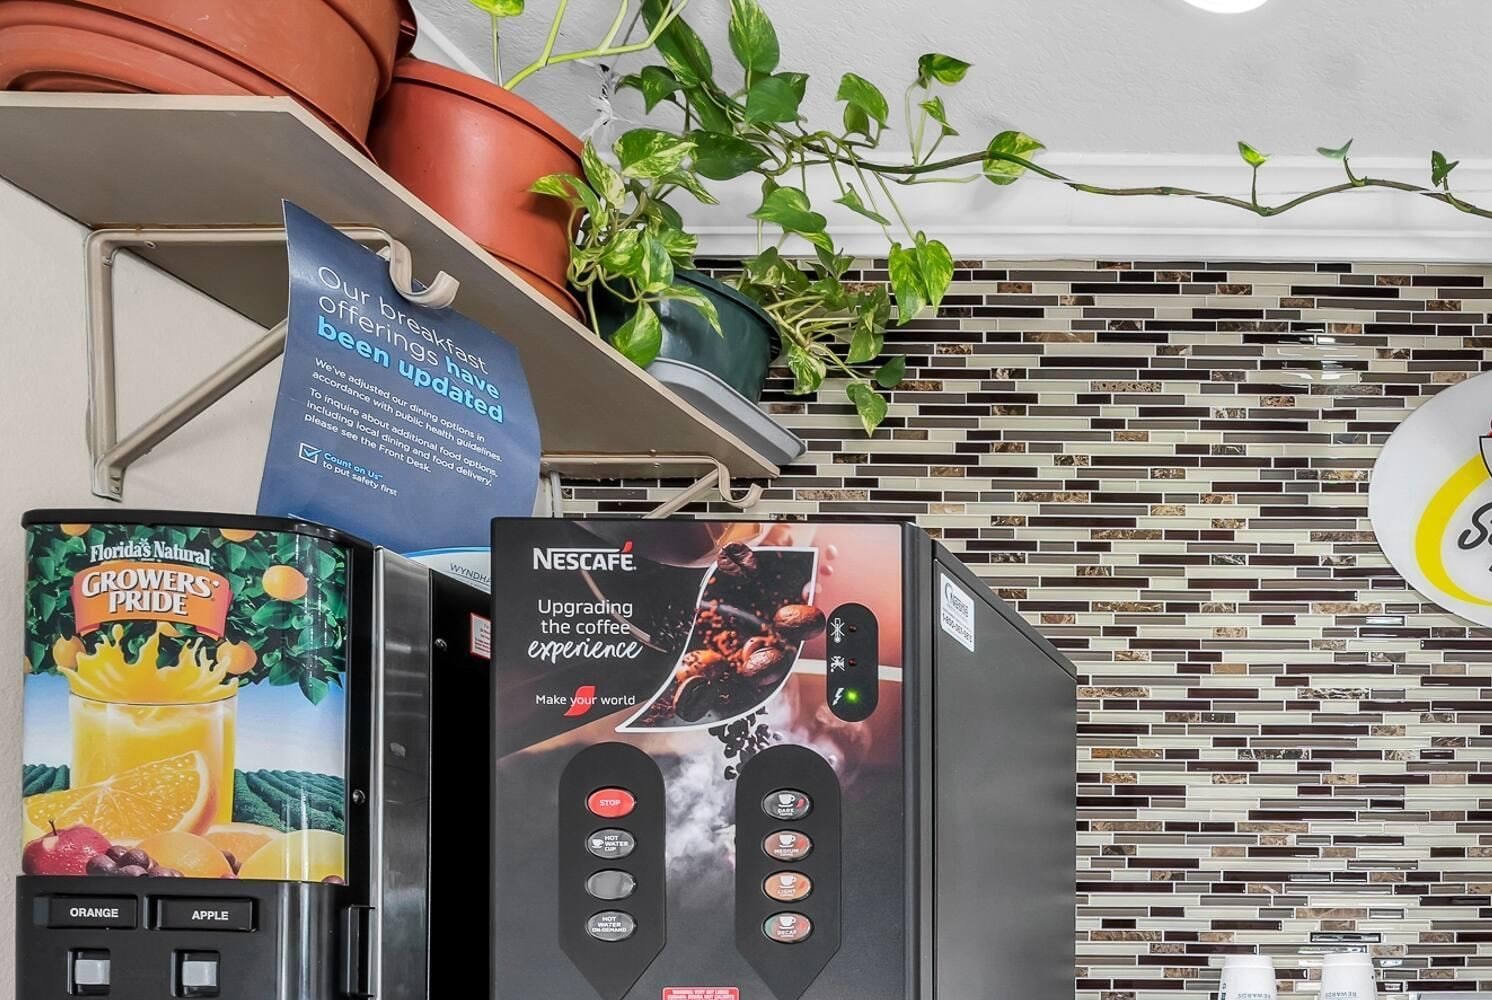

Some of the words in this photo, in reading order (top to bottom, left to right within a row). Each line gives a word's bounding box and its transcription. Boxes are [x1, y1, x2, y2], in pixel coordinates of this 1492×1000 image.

[318, 266, 370, 304] Our
[379, 296, 488, 375] breakfast
[319, 296, 439, 366] offerings
[445, 355, 500, 399] have
[317, 315, 390, 368] been
[399, 359, 503, 423] updated
[315, 357, 346, 379] We've
[348, 375, 390, 399] adjusted
[392, 396, 408, 408] our
[409, 404, 439, 423] dining
[440, 419, 475, 438] options
[476, 432, 485, 442] in
[310, 387, 322, 400] To
[324, 394, 360, 416] inquire
[361, 412, 390, 430] about
[392, 426, 438, 451] additional
[439, 446, 462, 461] food
[312, 371, 371, 402] accordance
[373, 399, 394, 414] with
[395, 409, 424, 428] public
[426, 422, 454, 441] health
[456, 437, 502, 462] guidelines.
[304, 413, 339, 433] please
[341, 428, 359, 441] see
[360, 436, 377, 449] the
[379, 444, 404, 462] Front
[406, 455, 432, 473] Desk.
[356, 421, 379, 438] local
[381, 434, 410, 452] dining
[412, 447, 430, 460] and
[432, 455, 455, 470] food
[324, 452, 352, 469] Count
[354, 465, 366, 475] on
[323, 461, 333, 470] to
[334, 467, 350, 478] put
[352, 473, 379, 489] safety
[380, 484, 398, 496] first
[153, 541, 211, 566] Natural
[108, 590, 189, 616] PRIDE
[538, 599, 633, 617] Upgrading
[541, 619, 571, 635] the
[576, 619, 631, 635] coffee
[527, 638, 644, 664] experience
[535, 694, 567, 705] Make
[570, 695, 597, 707] your
[601, 695, 636, 706] world
[599, 799, 621, 807] STOP
[69, 907, 119, 918] ORANGE
[191, 910, 229, 921] APPLE
